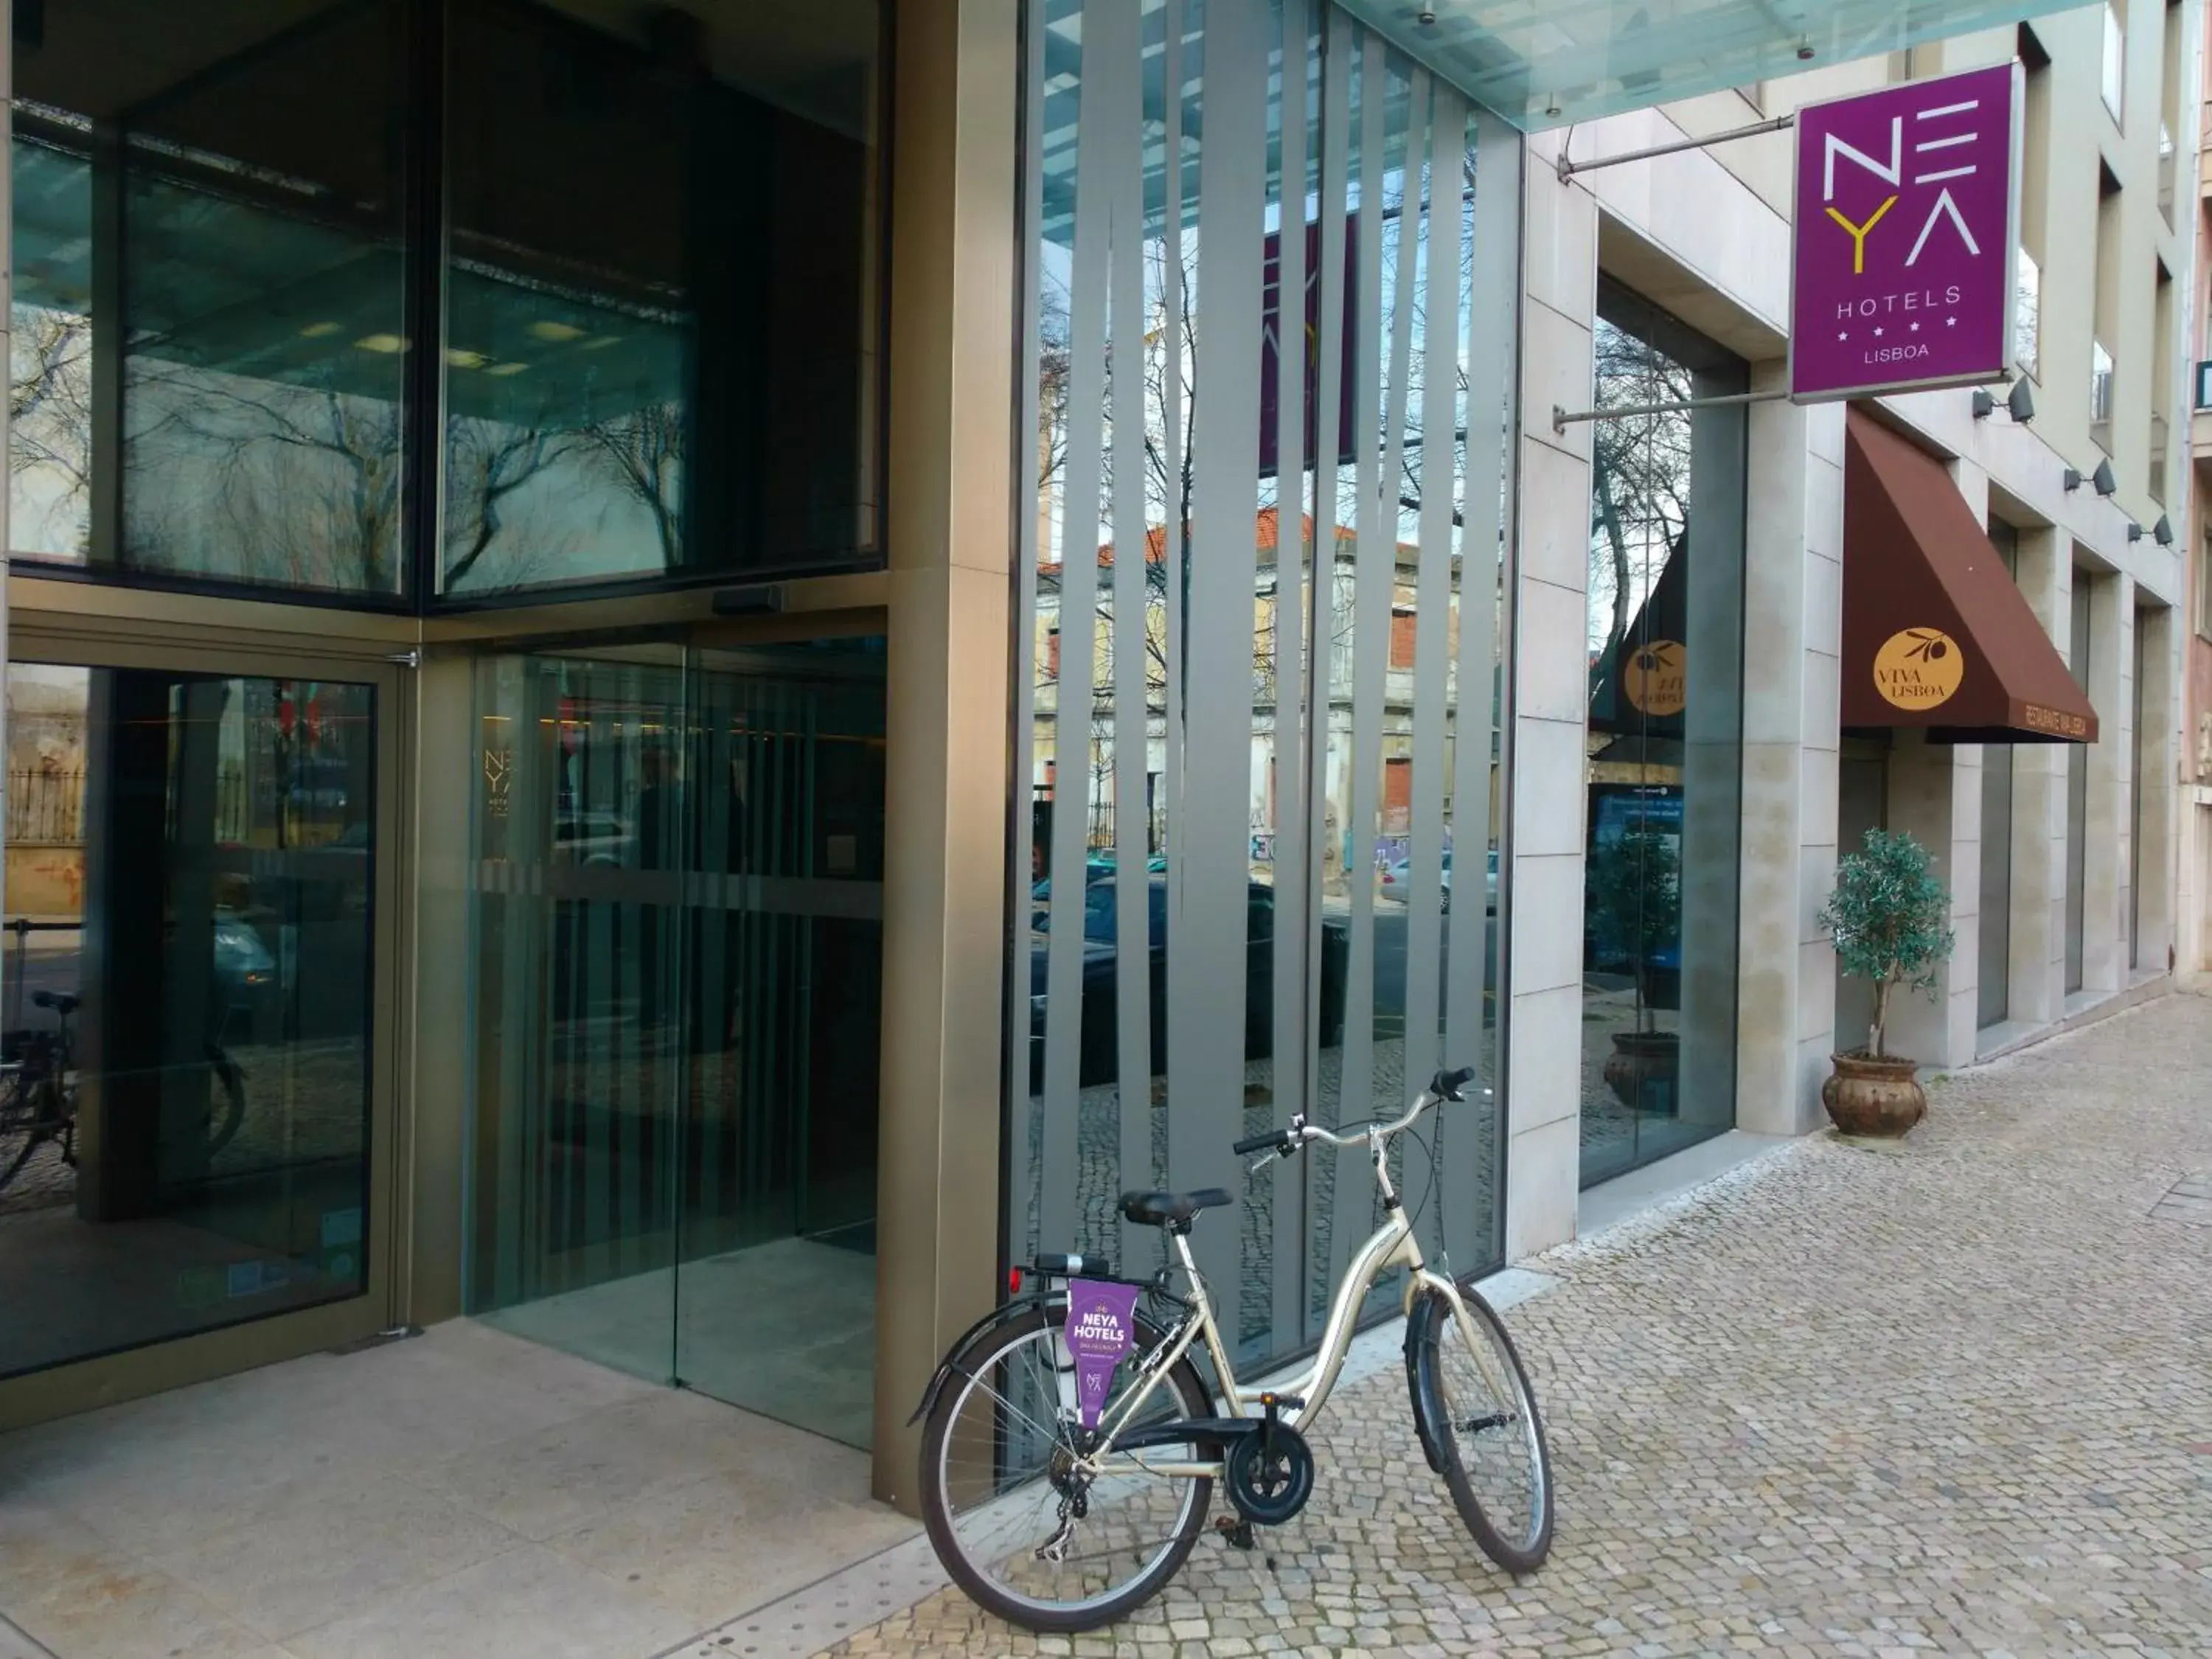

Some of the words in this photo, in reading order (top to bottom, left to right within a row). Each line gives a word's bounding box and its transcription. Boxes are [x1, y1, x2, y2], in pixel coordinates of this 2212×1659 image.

[1837, 285, 1961, 319] HOTELS
[1864, 344, 1930, 364] LISBOA
[1878, 668, 1922, 684] VIVA
[1891, 685, 1945, 698] LISBOA
[1083, 1312, 1118, 1327] NEYA
[1074, 1326, 1124, 1342] HOTELS
